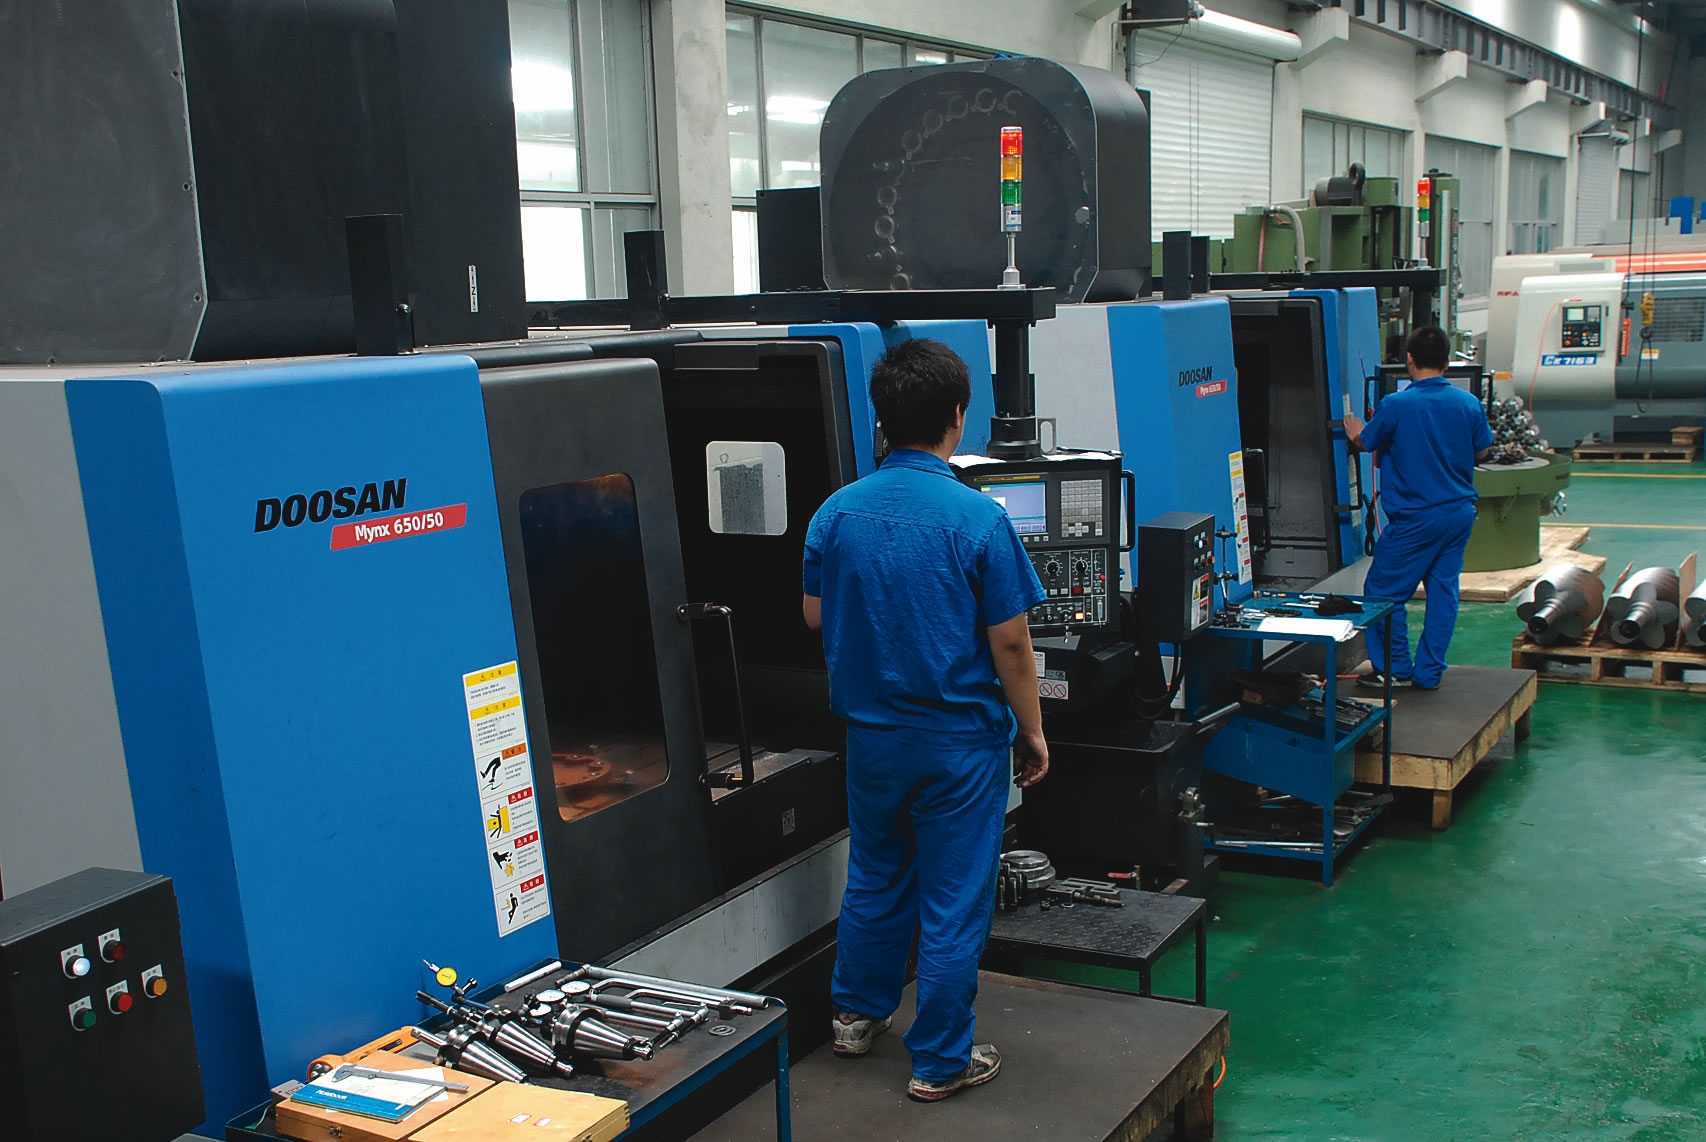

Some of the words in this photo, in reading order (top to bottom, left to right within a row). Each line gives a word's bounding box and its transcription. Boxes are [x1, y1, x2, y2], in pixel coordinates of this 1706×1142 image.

[1179, 366, 1212, 387] DOOSAN
[254, 478, 407, 533] DOOSAN
[354, 524, 391, 543] Mynx
[393, 511, 444, 535] 650/50
